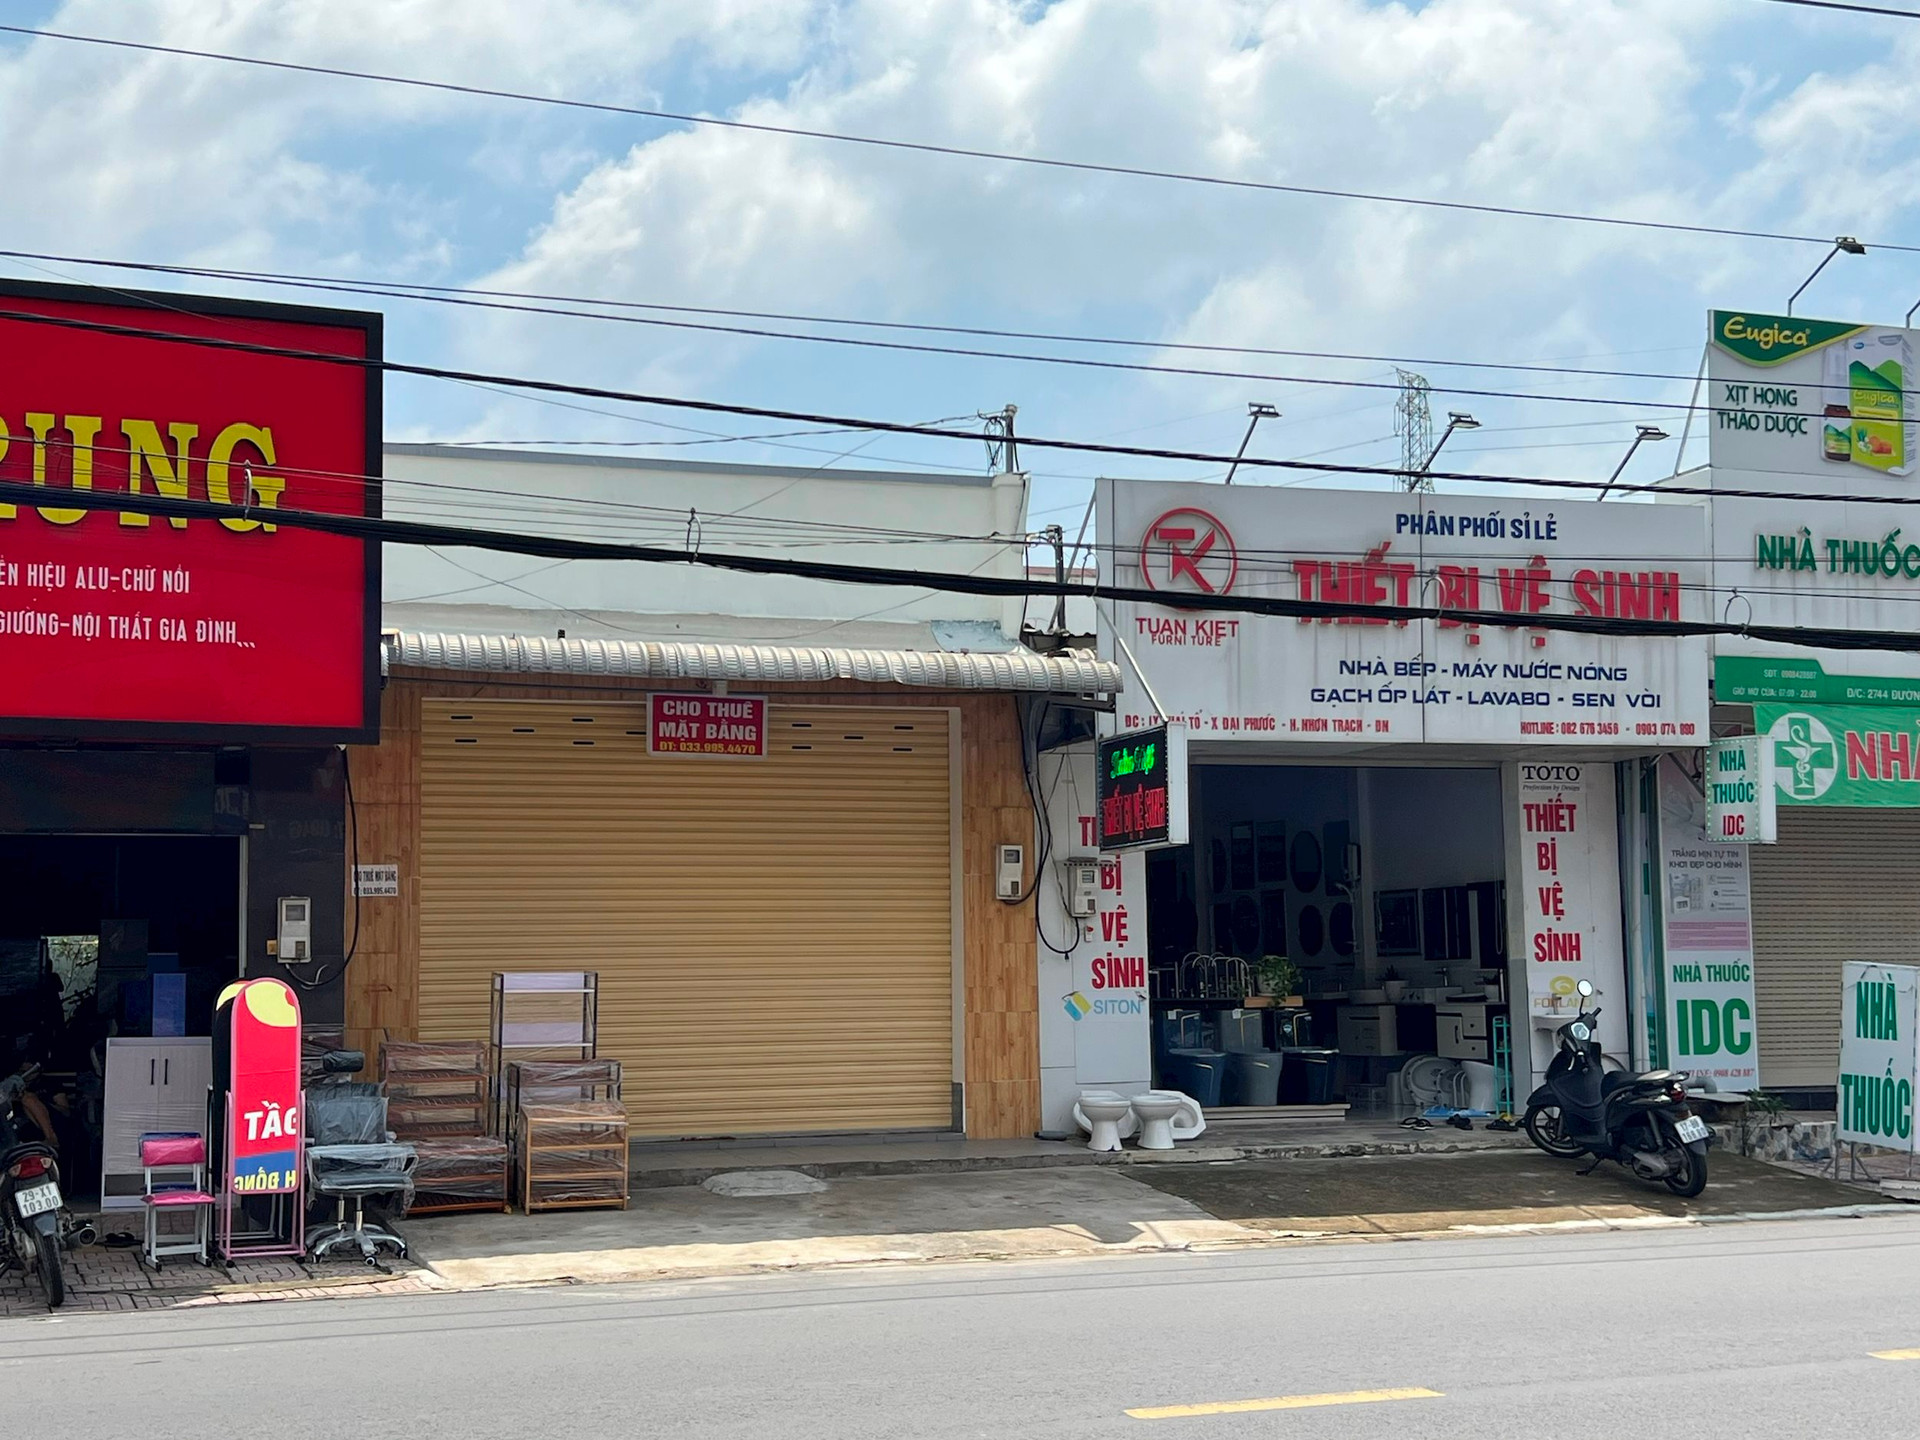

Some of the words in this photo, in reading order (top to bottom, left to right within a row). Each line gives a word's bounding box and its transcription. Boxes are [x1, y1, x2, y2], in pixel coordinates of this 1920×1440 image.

[1724, 316, 1810, 350] Eugica
[1725, 384, 1749, 406] XỊT
[1753, 386, 1798, 409] HỌNG
[1764, 414, 1808, 438] DƯỢC
[1396, 510, 1454, 536] PHÂN
[1459, 511, 1505, 538] PHỐI
[1511, 512, 1531, 539] SỈ
[1535, 513, 1557, 540] LẺ
[1755, 526, 1817, 572] NHÀ
[1825, 528, 1920, 579] THUỐC
[27, 561, 66, 592] HIỆU
[162, 563, 190, 594] NỔI
[1290, 541, 1416, 628] THIẾT
[1436, 565, 1480, 647] BỊ
[1568, 568, 1680, 624] SINH
[108, 611, 152, 640] THẤT
[159, 618, 187, 642] GIA
[1135, 617, 1187, 636] TUAN
[1195, 619, 1240, 638] KIET
[1339, 655, 1388, 676] NHÀ
[1394, 652, 1437, 677] BẾP
[1452, 657, 1498, 678] MÁY
[1503, 658, 1562, 680] NƯỚC
[1567, 661, 1628, 681] NÓNG
[662, 699, 701, 717] CHO
[706, 700, 753, 719] THUÊ
[1310, 688, 1373, 708] GẠCH
[1378, 681, 1407, 703] ỐP
[1412, 685, 1451, 705] LÁT
[1468, 690, 1550, 706] LAVABO
[1572, 693, 1615, 708] SEN
[1625, 687, 1661, 708] VÒI
[659, 718, 700, 741] MẶT
[705, 718, 757, 741] BẰNG
[1244, 713, 1276, 731] PHƯỚC
[1332, 718, 1363, 736] TRẠCH
[1719, 745, 1746, 771] NHÀ
[1844, 720, 1920, 783] NH
[1522, 765, 1581, 781] TOTO
[1712, 775, 1755, 804] THUỐC
[1723, 814, 1745, 836] IDC
[1538, 881, 1565, 921] VỆ
[1100, 904, 1129, 948] VỆ
[1672, 960, 1702, 982] NHÀ
[1705, 958, 1750, 982] THUỐC
[1093, 999, 1142, 1015] SITON
[1856, 973, 1898, 1041] NHÀ
[1676, 998, 1751, 1055] IDC
[1840, 1057, 1911, 1140] THUỐC
[23, 1195, 59, 1215] 103.00
